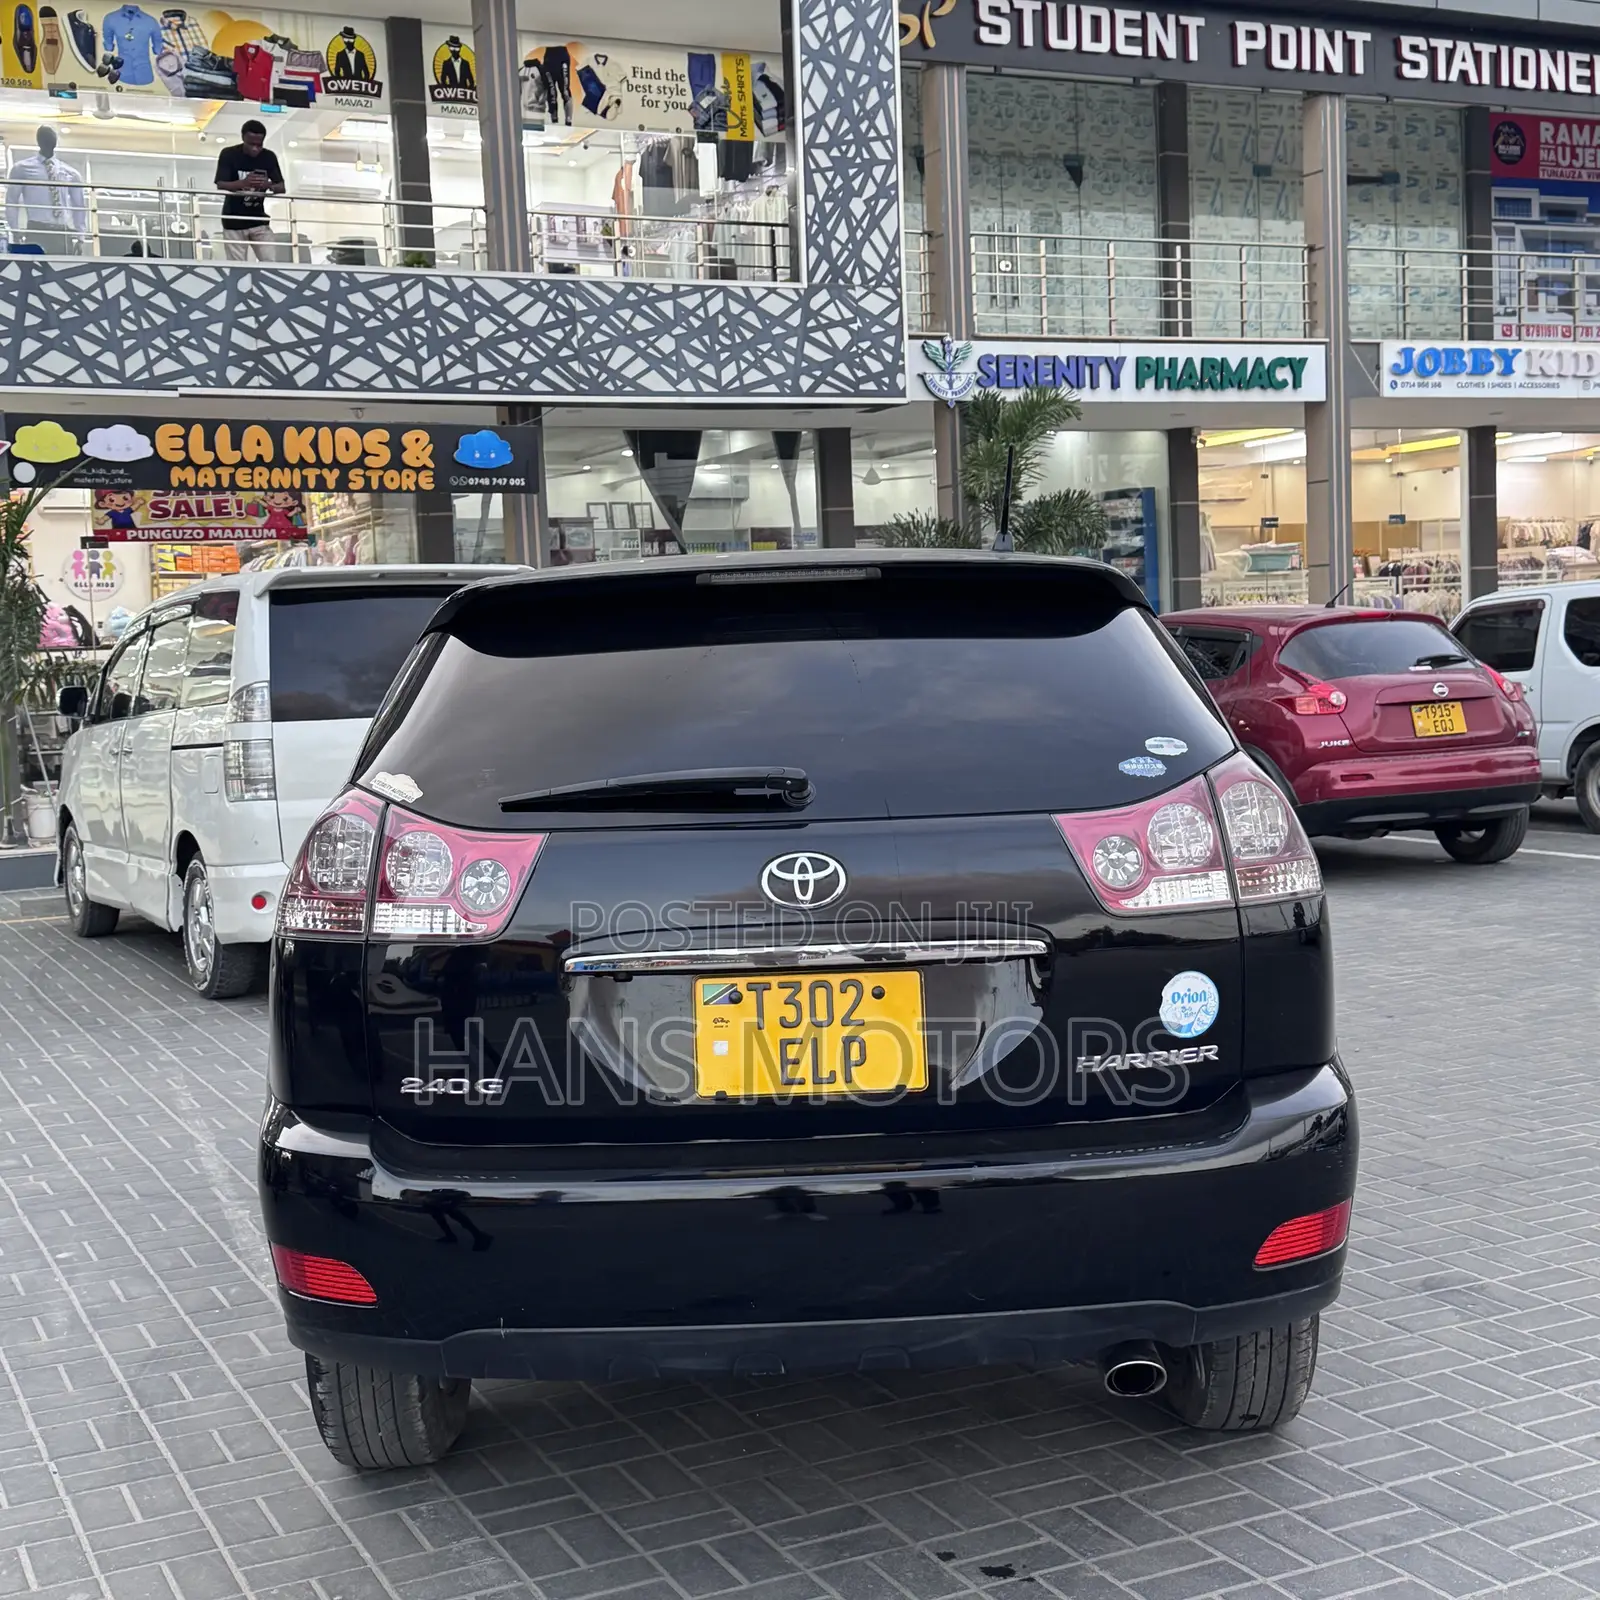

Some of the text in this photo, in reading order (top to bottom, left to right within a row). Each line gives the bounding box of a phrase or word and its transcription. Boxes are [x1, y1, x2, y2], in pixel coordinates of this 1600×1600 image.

[977, 0, 1600, 96] STUDENT POINT STATIONE
[632, 66, 686, 82] Find the
[735, 57, 747, 105] SHIRTS
[327, 79, 379, 95] QWETU
[626, 80, 687, 99] best style
[334, 97, 373, 109] MAVAZI
[440, 105, 478, 116] MAVAZI
[641, 95, 688, 113] for you
[1540, 148, 1556, 162] NA
[1557, 146, 1600, 168] UJE
[1540, 168, 1584, 179] TUNAUZA
[1390, 347, 1600, 378] JOBBY KID
[977, 354, 1308, 392] SERENITY PHARMACY
[1456, 381, 1486, 389] CLOTHES
[1518, 381, 1561, 390] ACCESSORIES
[154, 423, 436, 469] ELLA KIDS &
[170, 466, 436, 491] MATERNITY STORE
[491, 477, 507, 486] 747
[149, 496, 247, 519] SALE!
[126, 528, 277, 540] PUNGUZO MAALUM
[1423, 703, 1452, 719] T915
[746, 979, 866, 1030] T302
[779, 1035, 867, 1086] ELP
[1075, 1044, 1220, 1073] HARRIER
[400, 1076, 504, 1094] 240 G
